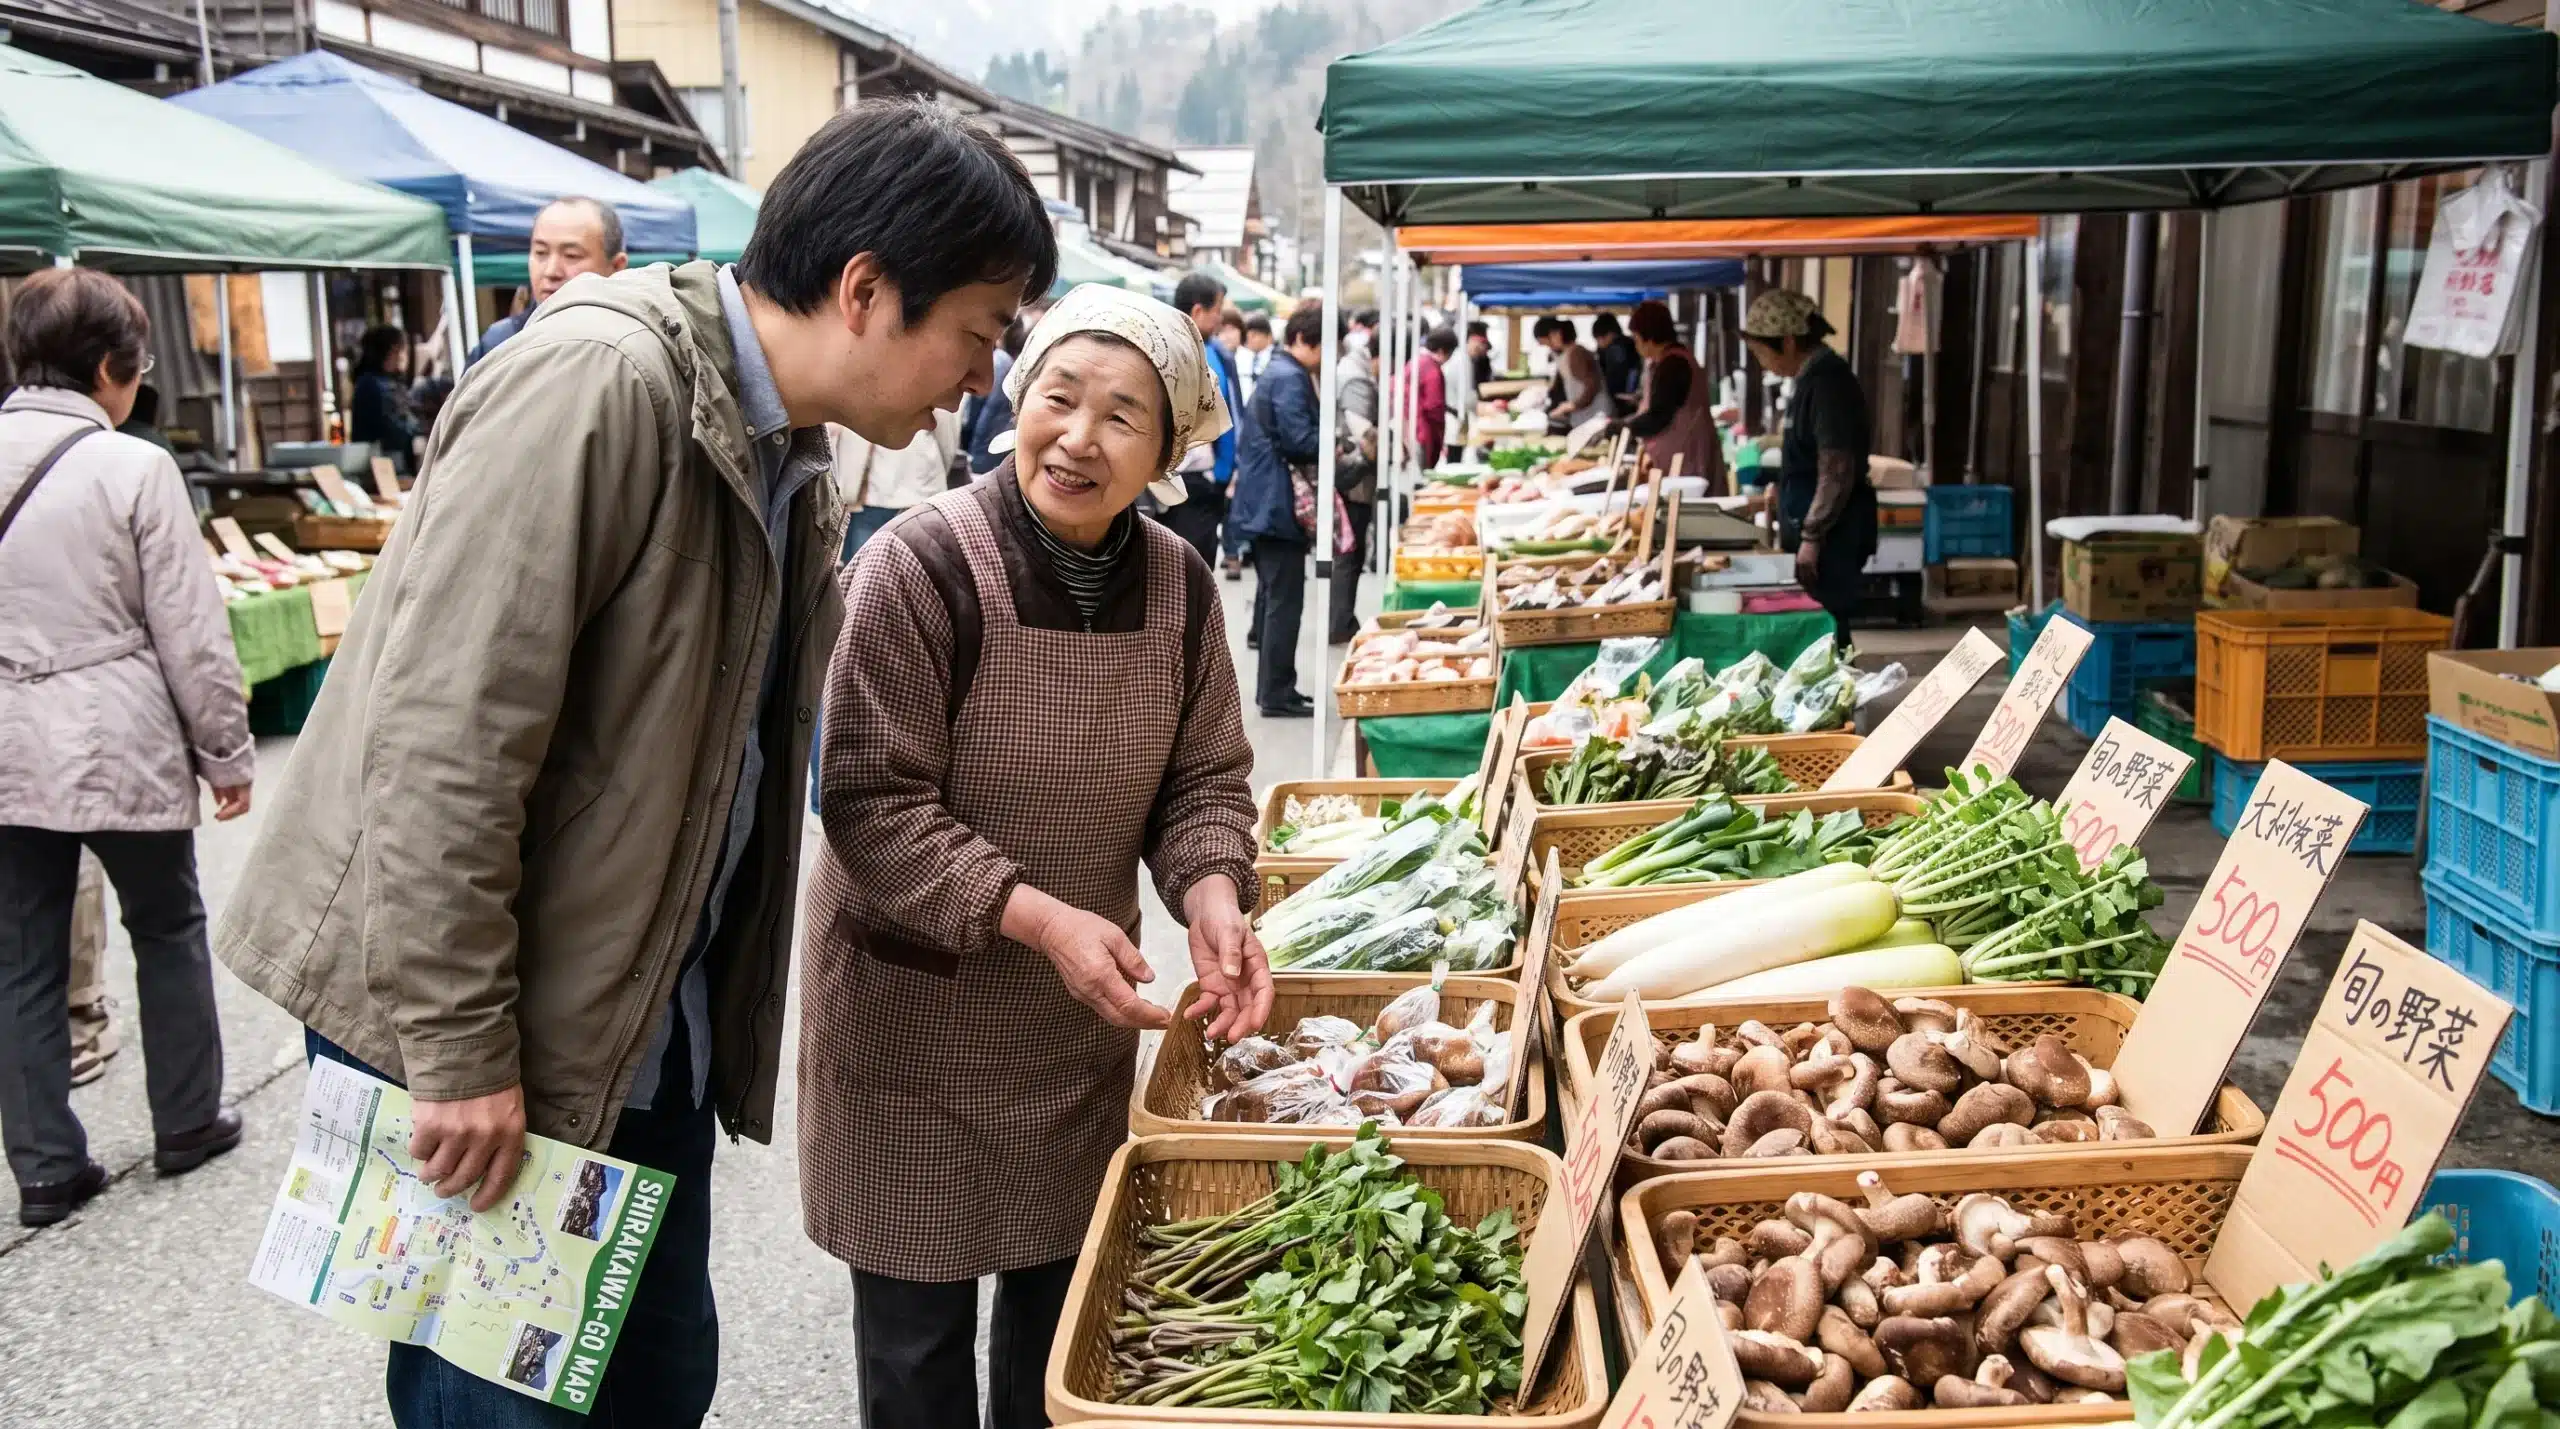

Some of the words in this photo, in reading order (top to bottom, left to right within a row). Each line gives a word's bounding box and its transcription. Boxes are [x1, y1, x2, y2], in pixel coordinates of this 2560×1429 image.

[2091, 731, 2175, 810] 旬の野菜
[2196, 864, 2277, 981] 500円
[2343, 948, 2478, 1093] 旬の野菜
[2293, 1056, 2405, 1211] 500円
[580, 1178, 664, 1351] SHIRAKAWA-GO
[562, 1355, 600, 1405] MAP
